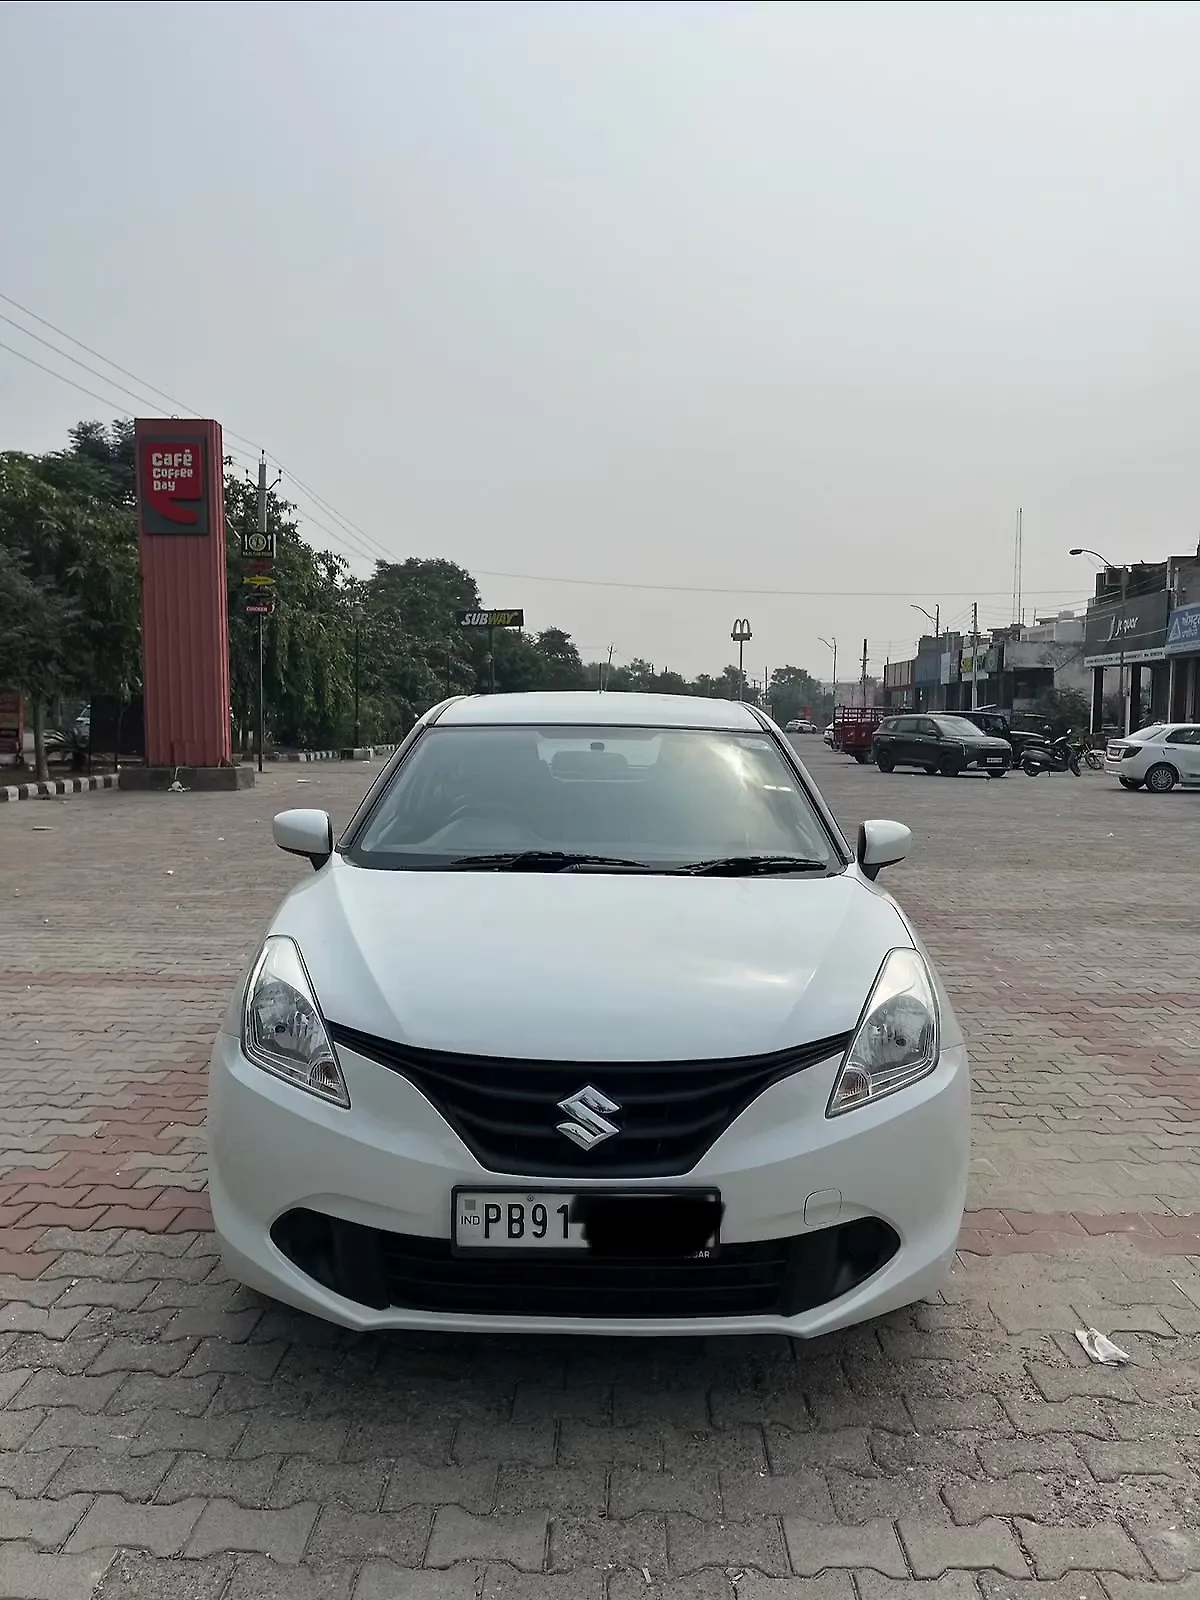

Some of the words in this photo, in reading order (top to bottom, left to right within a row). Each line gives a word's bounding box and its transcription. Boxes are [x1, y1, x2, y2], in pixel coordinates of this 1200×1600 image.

[152, 468, 193, 479] Coffee
[153, 480, 176, 491] Day
[461, 612, 514, 626] SUBWAY
[460, 1215, 480, 1226] IND
